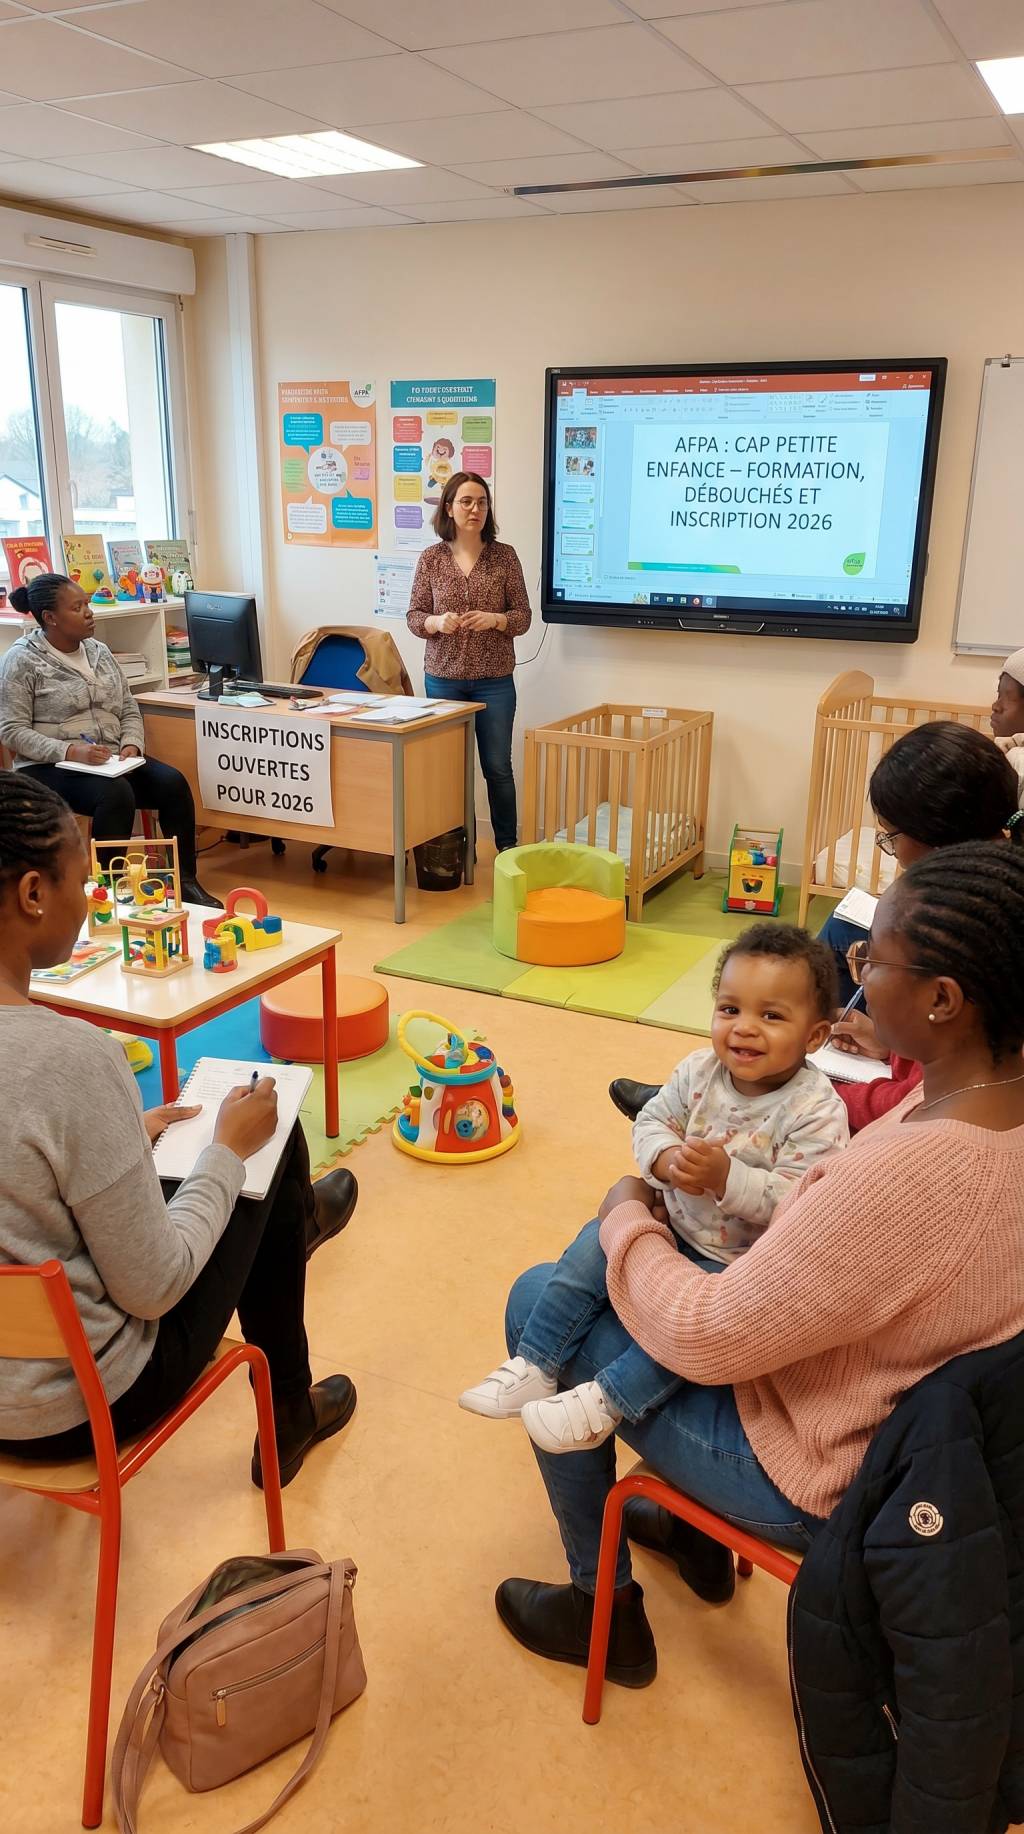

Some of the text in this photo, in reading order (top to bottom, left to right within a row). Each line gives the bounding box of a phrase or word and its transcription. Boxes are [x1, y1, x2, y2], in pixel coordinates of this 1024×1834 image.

[674, 435, 719, 454] AFPA
[734, 435, 770, 454] CAP
[776, 435, 838, 454] PETITE
[646, 461, 725, 478] ENFANCE
[747, 461, 865, 486] FORMATION,
[685, 483, 821, 505] DÉBOUCHÉS ET
[670, 510, 833, 531] INSCRIPTION 2026
[202, 719, 325, 751] INSCRIPTIONS
[217, 754, 310, 781] OUVERTES
[217, 784, 314, 813] POUR 2026
